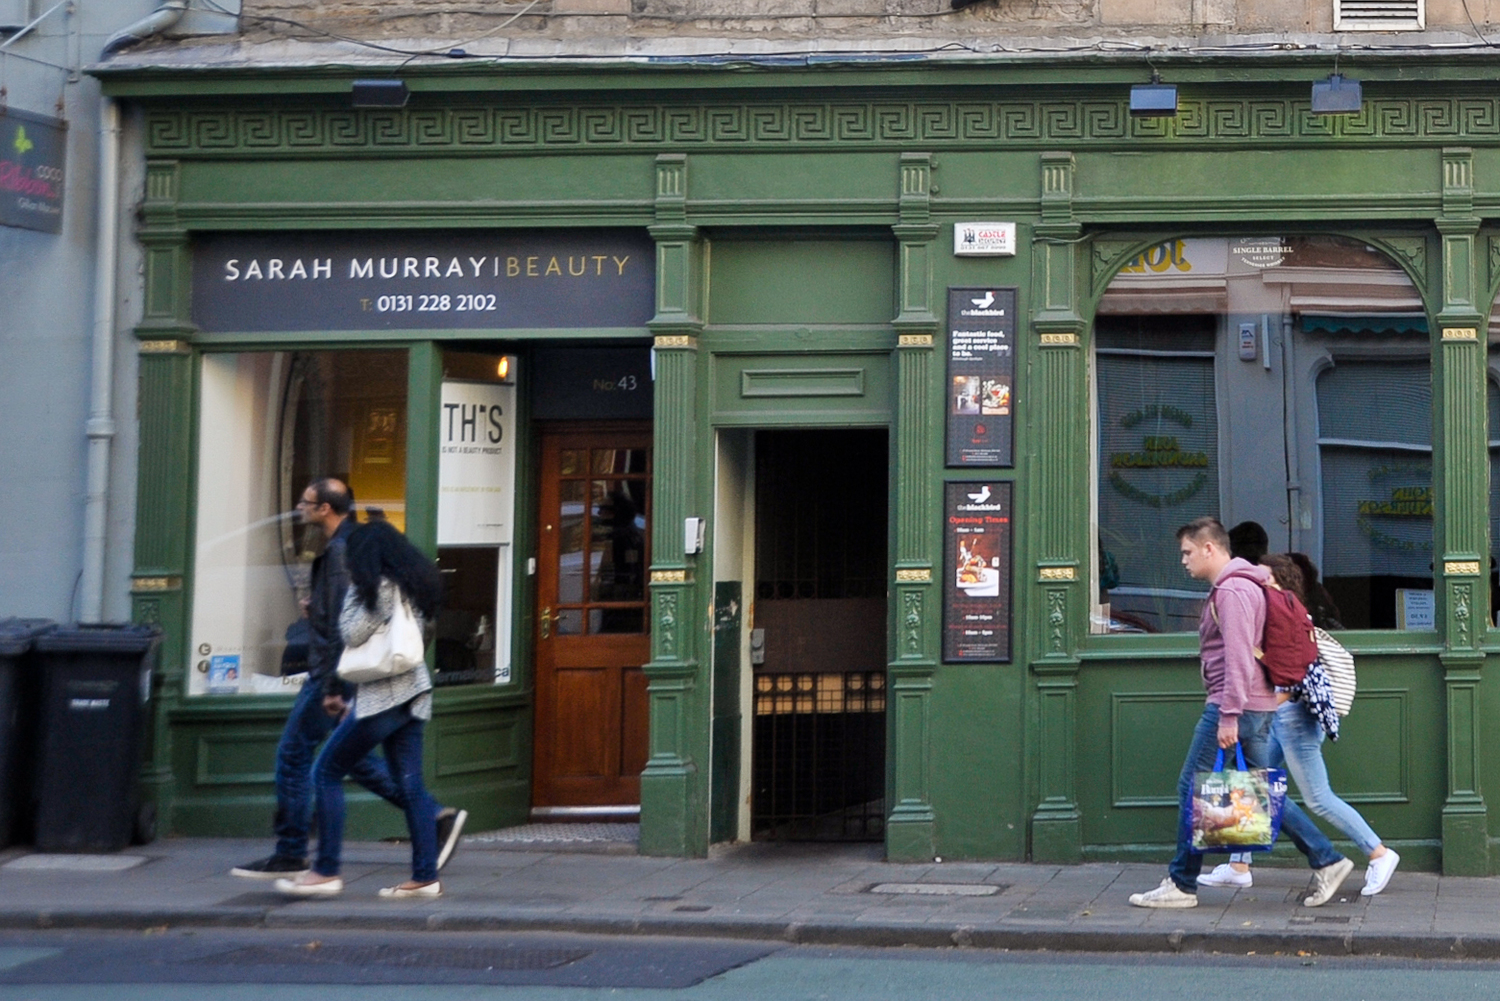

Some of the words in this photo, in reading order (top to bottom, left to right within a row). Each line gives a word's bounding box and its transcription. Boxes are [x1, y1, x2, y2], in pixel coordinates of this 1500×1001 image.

[1233, 246, 1262, 254] SINGLE
[1262, 246, 1294, 254] BARREL
[225, 258, 332, 281] SARAH
[349, 257, 487, 279] MURRAY
[506, 256, 630, 276] BEAUTY
[360, 298, 373, 312] T:
[377, 295, 413, 312] 0131
[418, 295, 451, 311] 228
[455, 294, 497, 311] 2102
[952, 330, 986, 338] Fantastic
[949, 516, 983, 525] Opening
[984, 515, 1009, 524] Times
